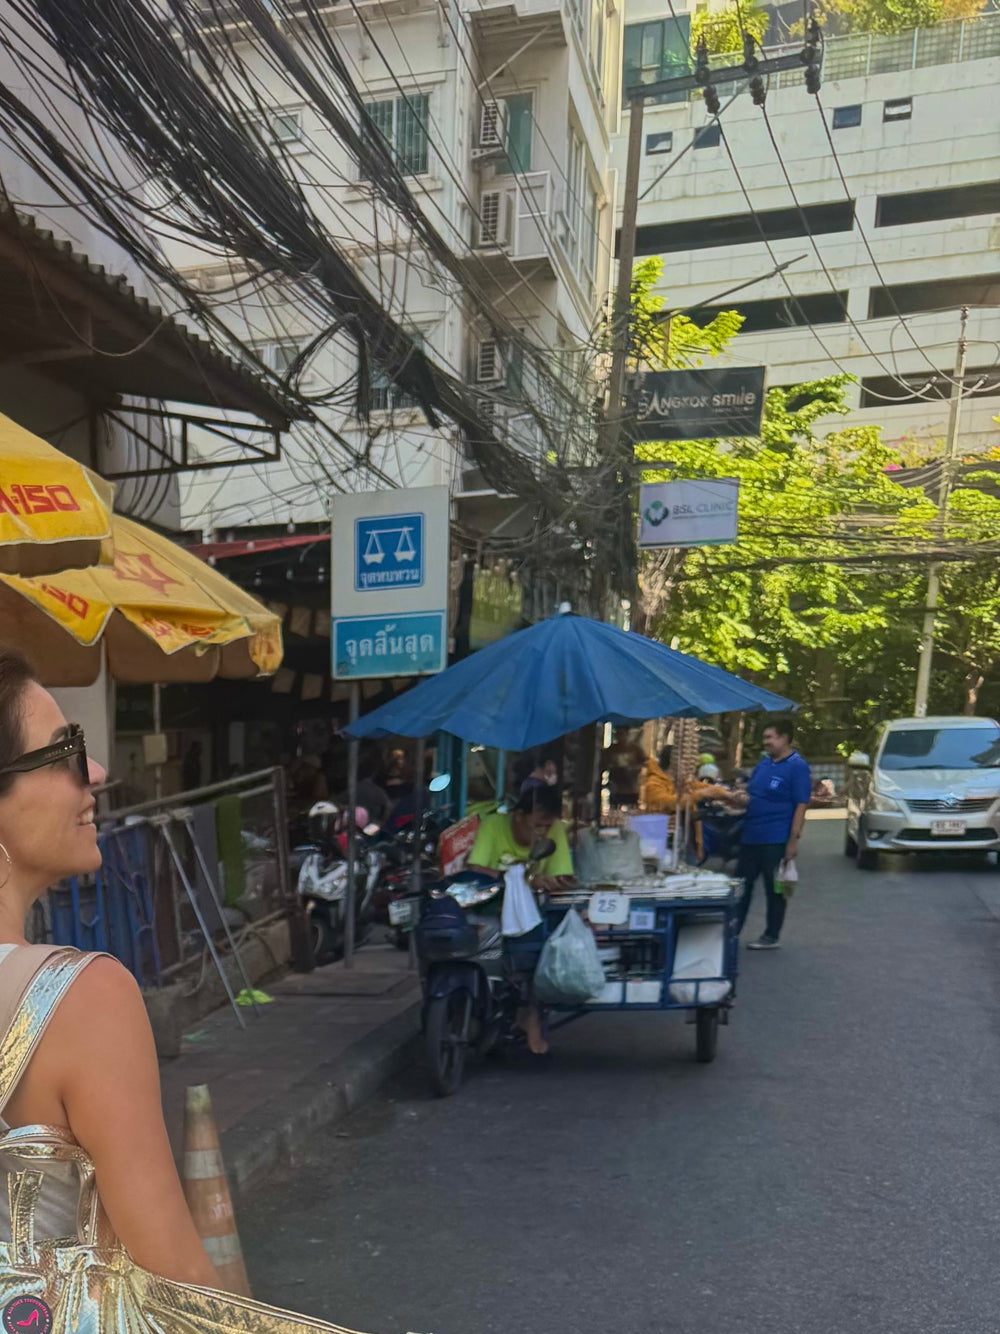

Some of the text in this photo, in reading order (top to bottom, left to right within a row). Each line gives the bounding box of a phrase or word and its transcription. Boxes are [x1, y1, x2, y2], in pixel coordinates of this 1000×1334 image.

[695, 501, 735, 513] CLINIC
[345, 623, 434, 665] จุดสิ้นสุด
